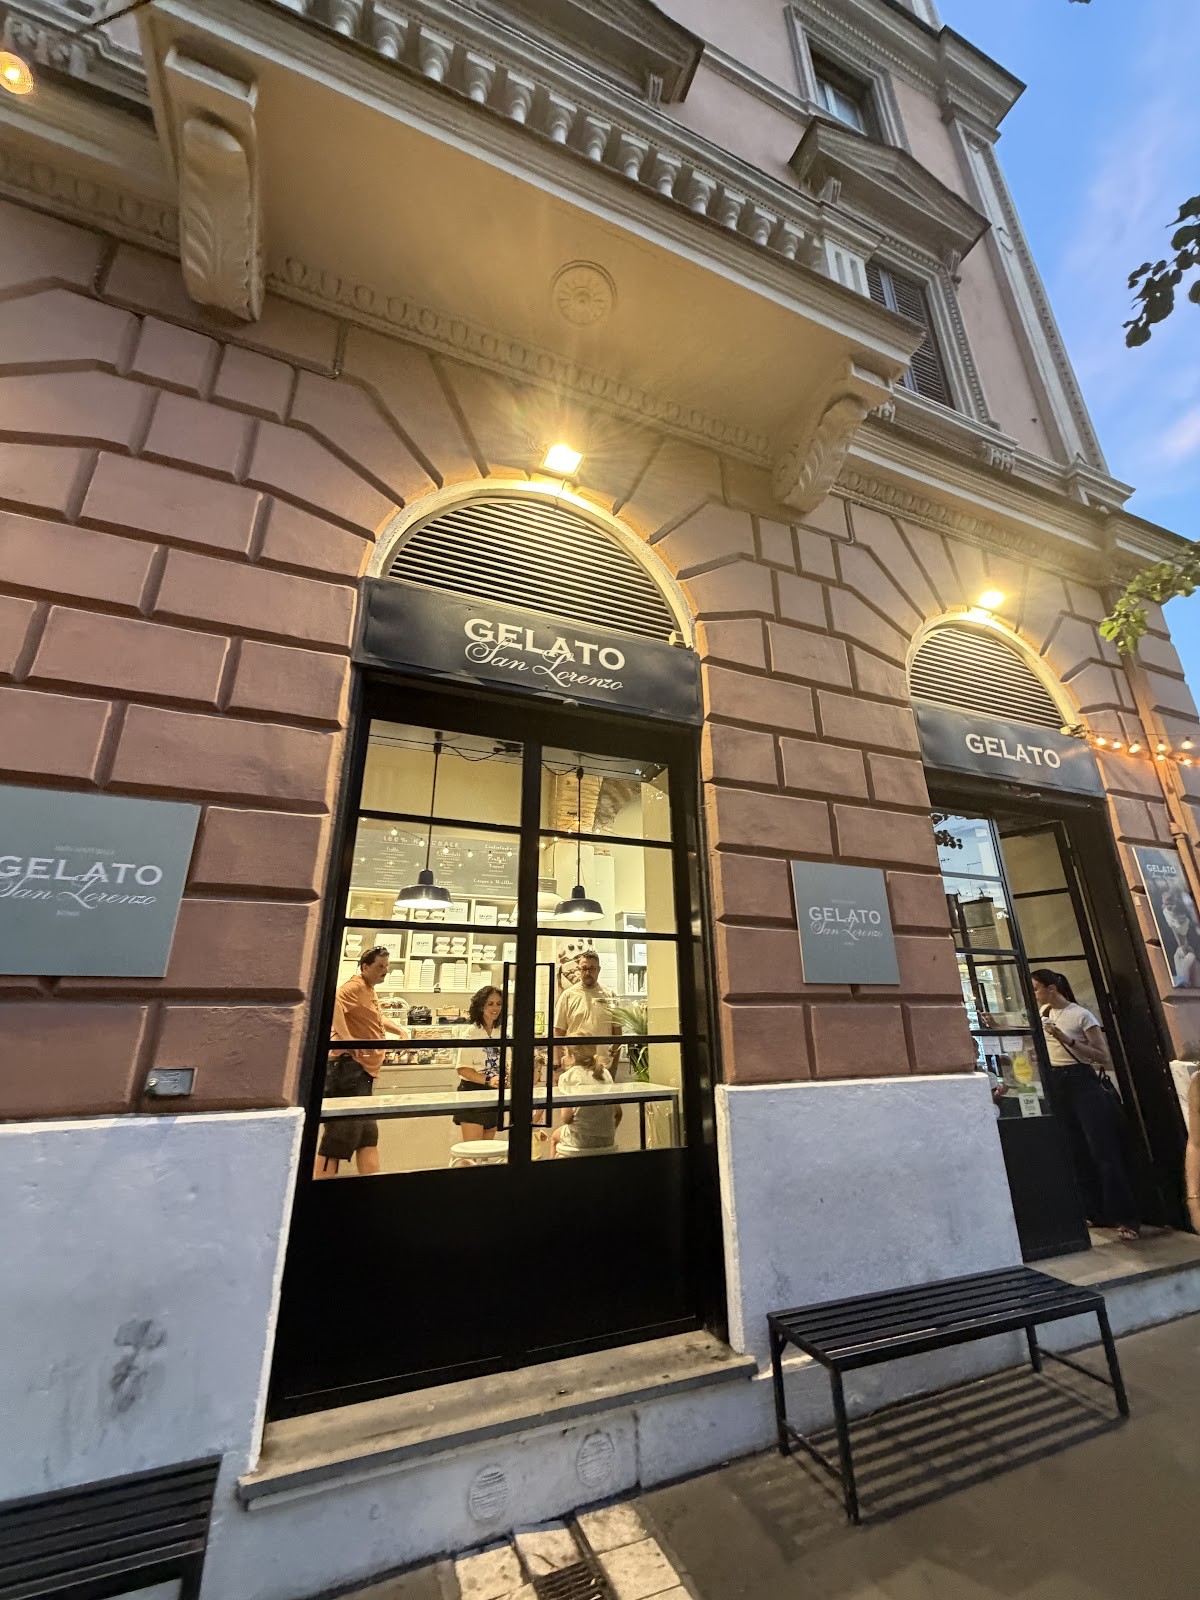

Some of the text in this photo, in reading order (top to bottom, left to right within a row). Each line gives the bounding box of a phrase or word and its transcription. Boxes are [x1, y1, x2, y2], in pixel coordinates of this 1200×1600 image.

[464, 618, 626, 671] GELATO
[465, 637, 624, 690] San Lorenzo
[965, 733, 1061, 769] GELATO
[0, 855, 164, 886] GELATO
[1146, 865, 1177, 874] GELATO
[56, 873, 156, 909] Lorenzo
[808, 906, 881, 924] GELATO
[810, 919, 883, 940] San Lorenzo
